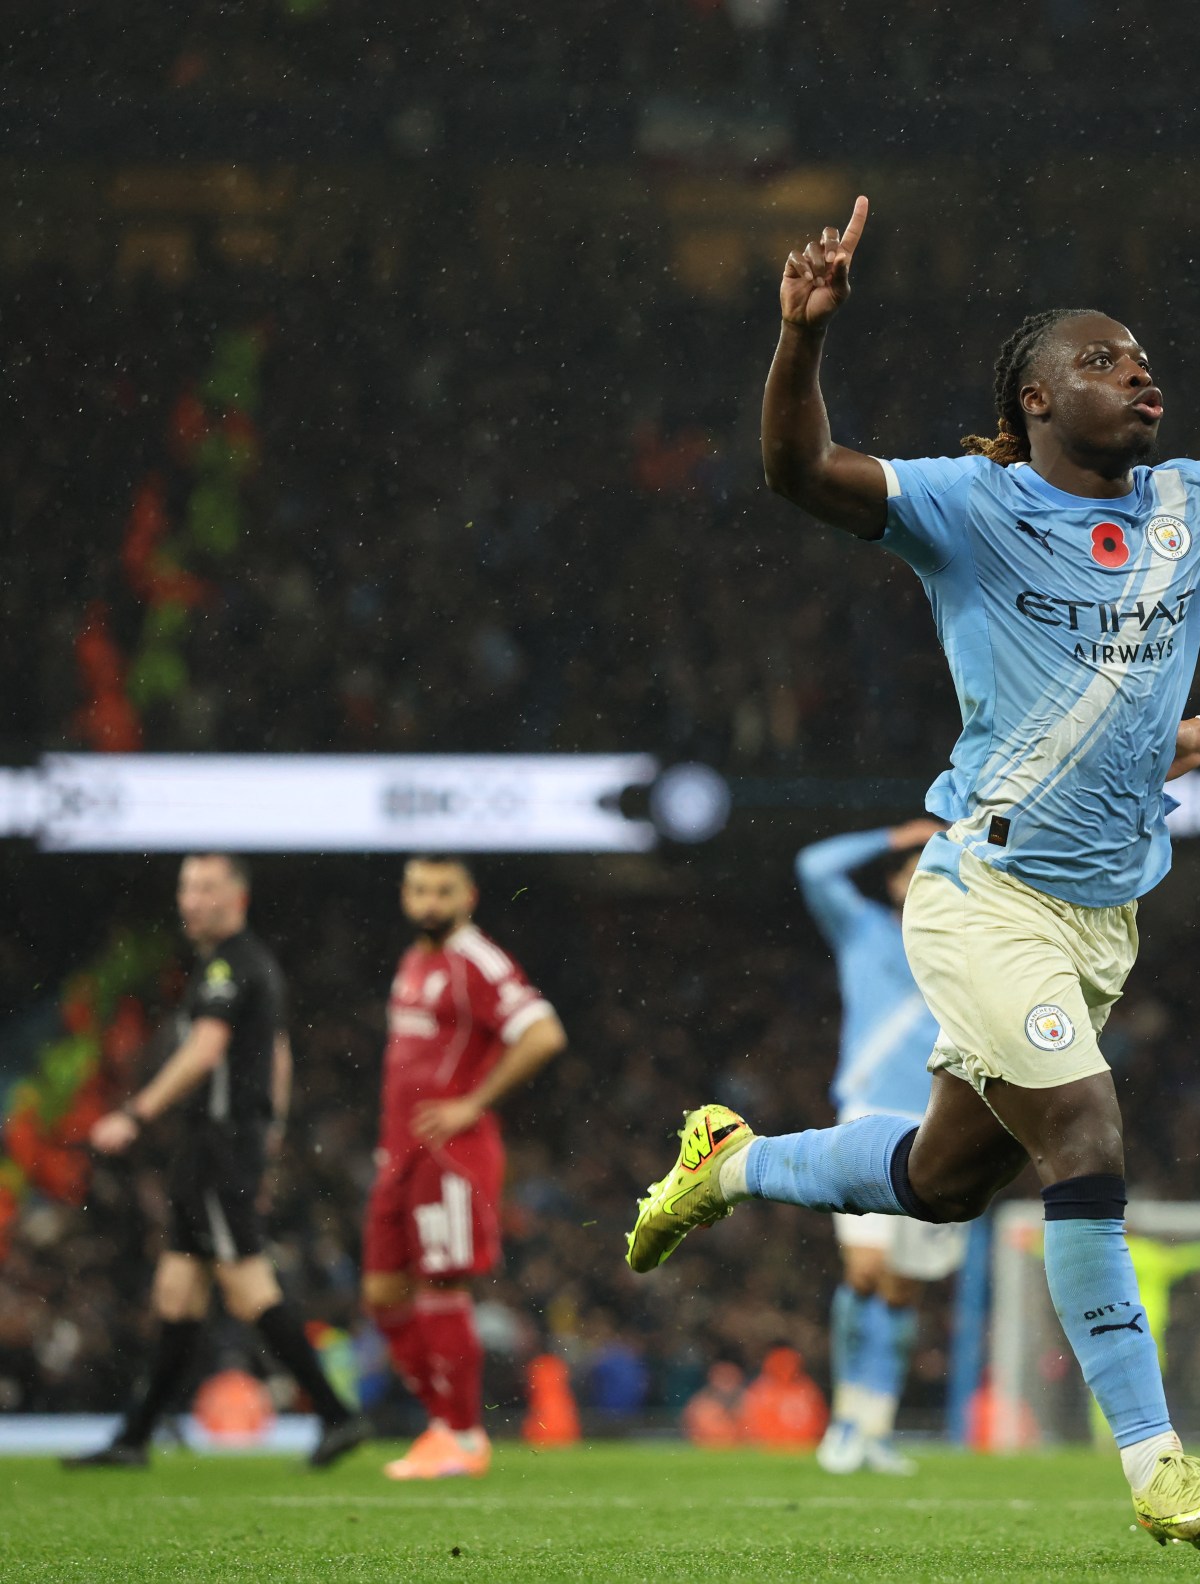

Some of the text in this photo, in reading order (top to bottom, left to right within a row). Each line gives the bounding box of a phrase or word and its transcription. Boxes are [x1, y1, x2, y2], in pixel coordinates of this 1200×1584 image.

[1171, 550, 1184, 558] CITY
[1073, 637, 1174, 664] AIRWAYS
[1053, 1039, 1066, 1048] CITY
